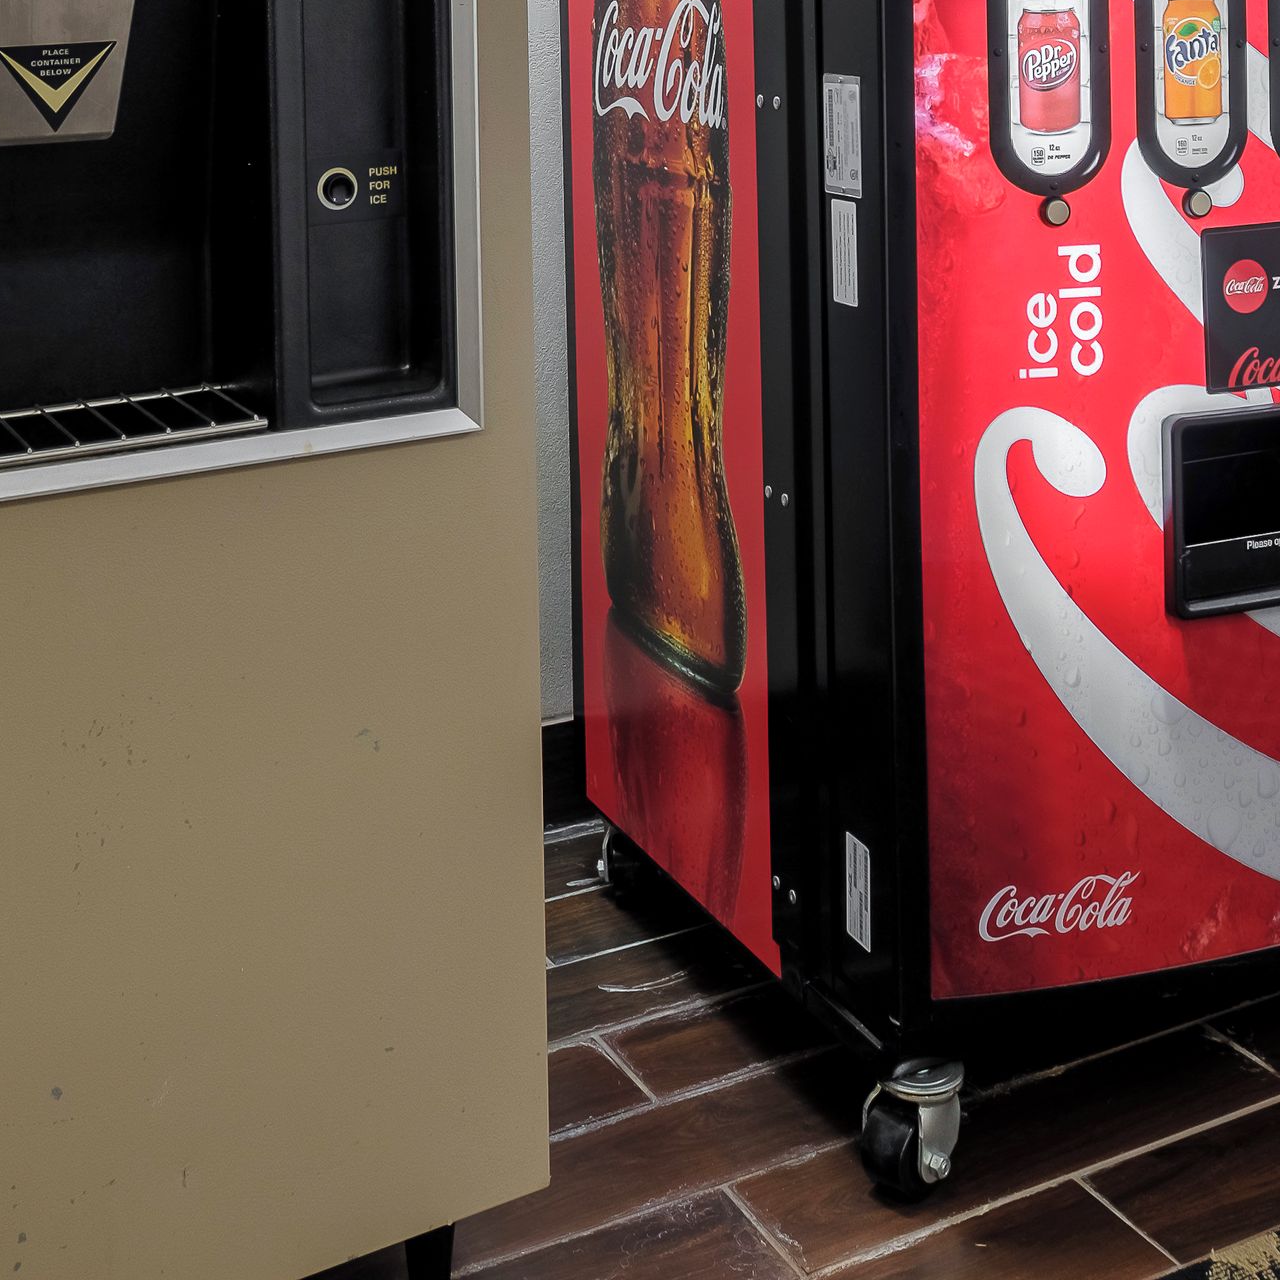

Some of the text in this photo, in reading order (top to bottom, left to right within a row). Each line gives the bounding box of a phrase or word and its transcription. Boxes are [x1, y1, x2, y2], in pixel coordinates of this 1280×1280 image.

[42, 48, 70, 57] PLACE
[1040, 44, 1063, 65] Dr
[1165, 25, 1220, 74] Fanta
[30, 57, 81, 67] CONTAINER
[1023, 49, 1074, 82] Pepper
[40, 68, 72, 77] BELOW
[369, 166, 397, 177] PUSH
[369, 180, 390, 190] FOR
[370, 194, 387, 205] ICE
[1225, 276, 1265, 296] Coca-Cola
[1058, 243, 1104, 377] cold
[1019, 291, 1059, 379] ice
[1246, 540, 1273, 550] Please
[978, 871, 1141, 942] Coca-Cola
